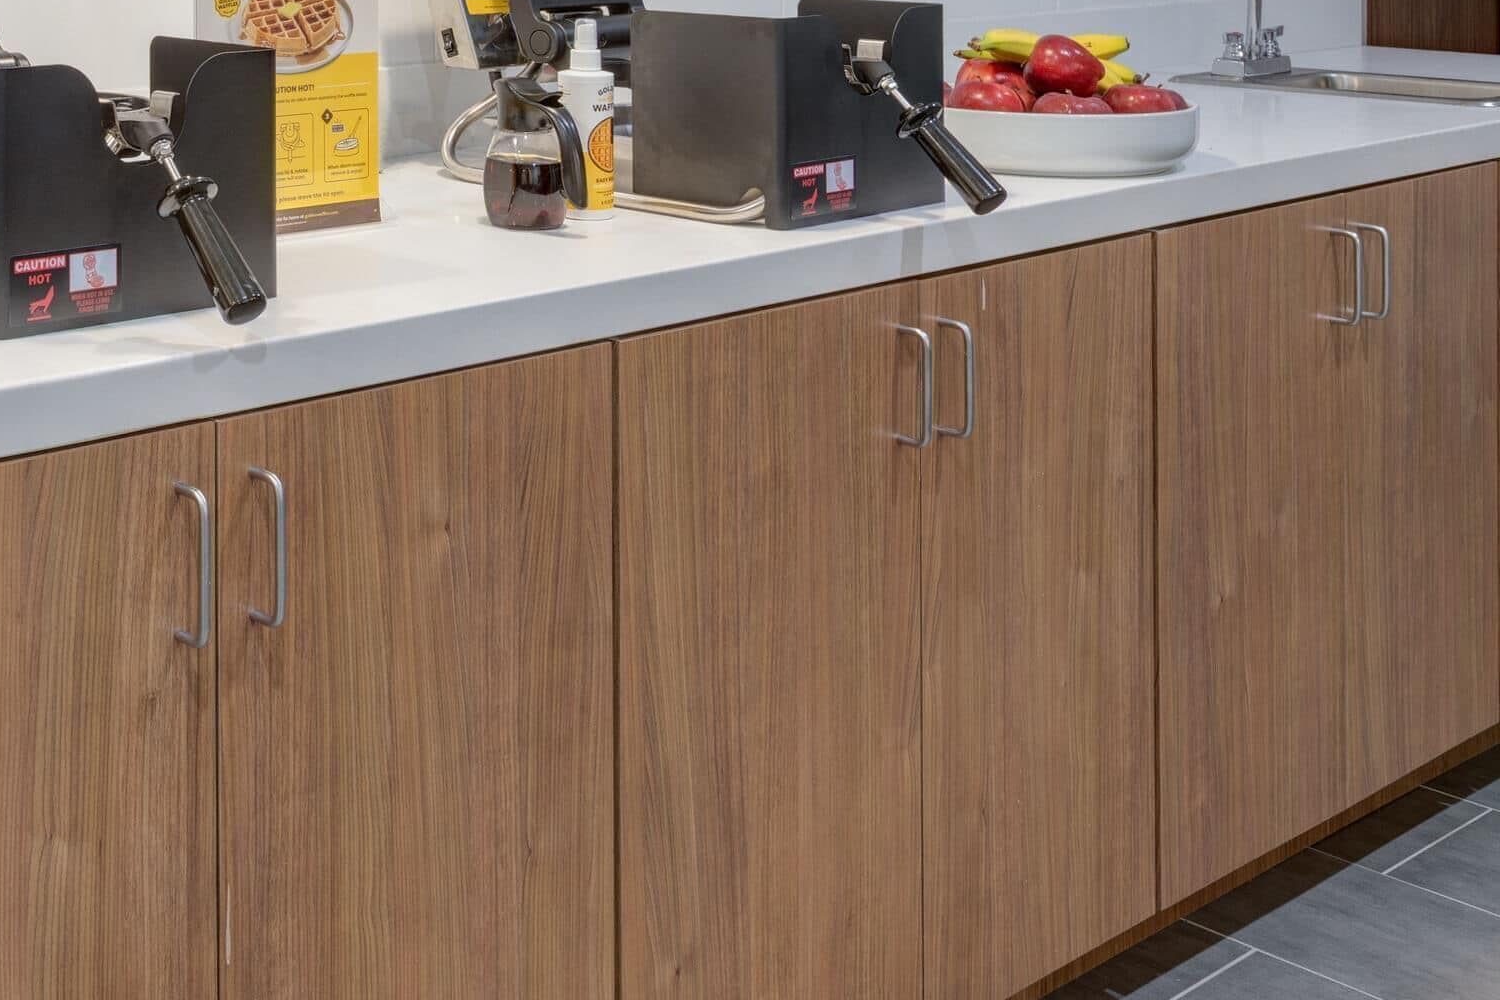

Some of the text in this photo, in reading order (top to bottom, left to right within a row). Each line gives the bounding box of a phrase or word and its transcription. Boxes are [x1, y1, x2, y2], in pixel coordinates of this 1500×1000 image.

[275, 84, 315, 94] UTION HOT!
[793, 164, 825, 178] CAUTION
[802, 178, 816, 187] HOT
[14, 255, 66, 273] CAUTION
[28, 273, 52, 286] HOT
